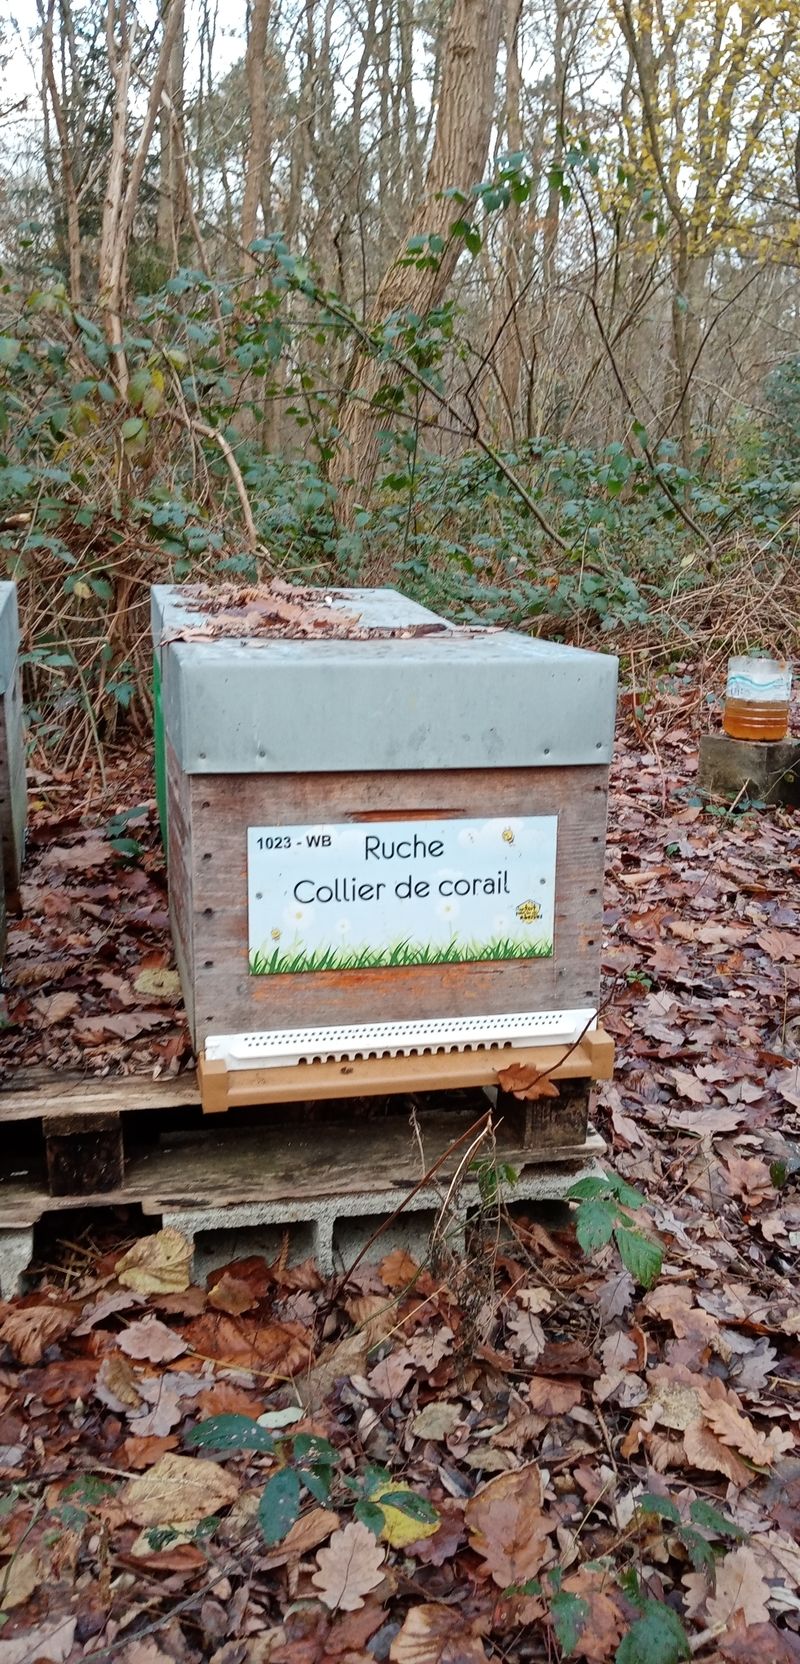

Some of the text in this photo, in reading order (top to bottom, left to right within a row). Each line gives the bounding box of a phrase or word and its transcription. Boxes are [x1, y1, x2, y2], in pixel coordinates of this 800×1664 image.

[256, 836, 292, 850] 1023
[306, 835, 332, 848] WB
[364, 834, 444, 861] Ruche
[293, 870, 511, 904] Collier de corail
